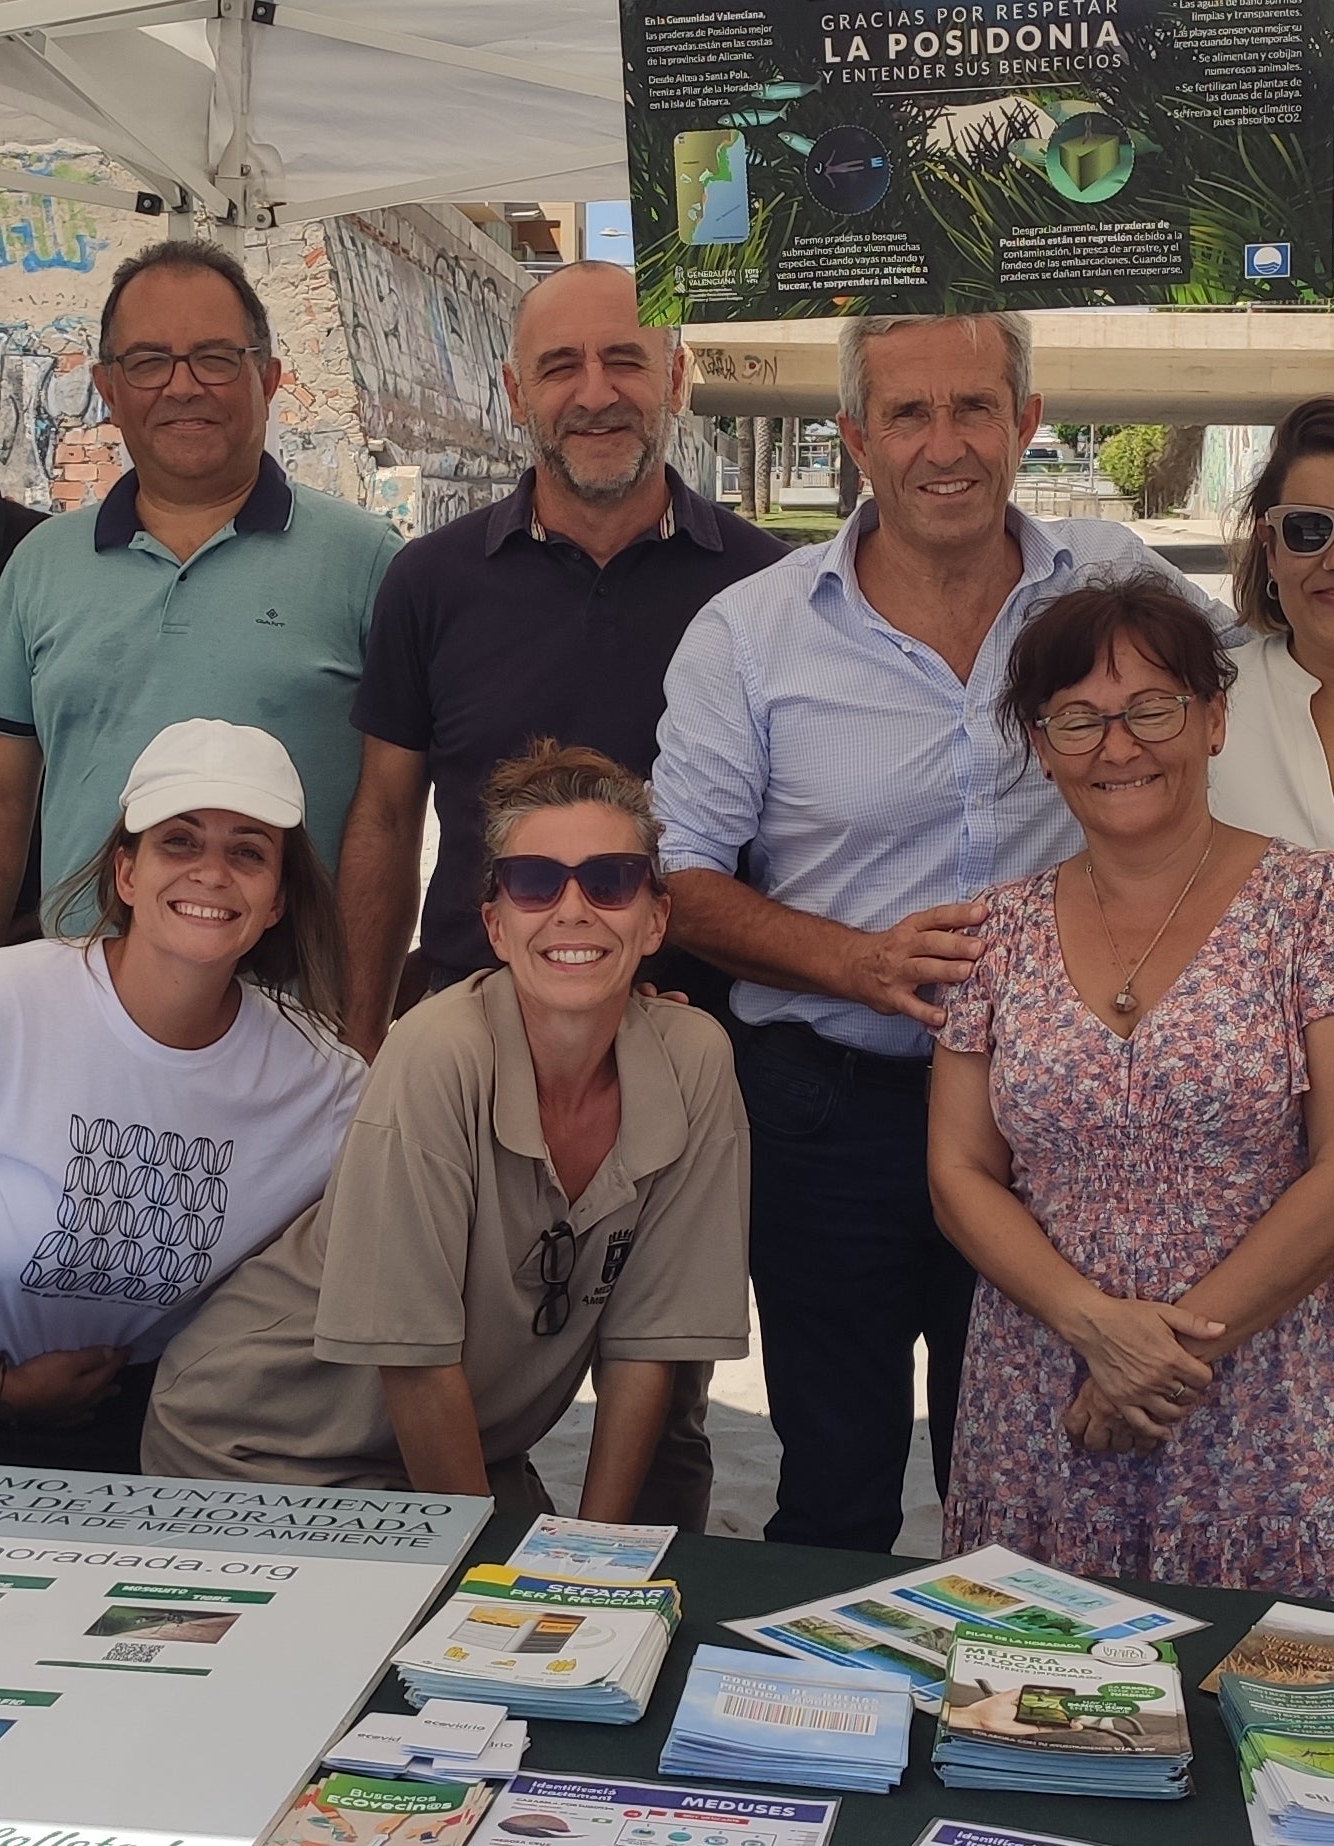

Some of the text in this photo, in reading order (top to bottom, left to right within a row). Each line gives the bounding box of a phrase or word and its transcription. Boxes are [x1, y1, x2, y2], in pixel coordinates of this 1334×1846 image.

[645, 17, 655, 26] En
[667, 13, 714, 24] Comunidad
[716, 10, 766, 21] Valenciana,
[821, 0, 1119, 31] GRACIAS POR RESPETAR
[1192, 9, 1302, 22] limpias y transparentes.
[646, 32, 657, 40] las
[659, 30, 694, 41] praderas
[708, 26, 746, 36] Posidonia
[749, 25, 773, 35] mejor
[1173, 29, 1188, 38] Las
[1190, 28, 1216, 38] playas
[1218, 25, 1263, 35] conservan
[1265, 23, 1290, 34] mejor
[823, 20, 1120, 63] LA POSIDONIA
[1199, 53, 1210, 62] Se
[1212, 52, 1258, 62] alimentan
[1268, 49, 1302, 59] cobijan
[822, 54, 1121, 85] Y ENTENDER SUS BENEFICIOS
[1205, 62, 1302, 76] numerosos animales.
[1182, 77, 1302, 92] Se fertilizan las plantas de
[1207, 89, 1302, 102] las dunas de la playa.
[1213, 118, 1235, 128] pues
[1238, 114, 1275, 124] absorbo
[86, 1483, 452, 1517] AYUNTAMIENTO
[28, 1496, 92, 1512] DE
[101, 1502, 158, 1516] LA
[168, 1503, 437, 1534] HORADADA
[81, 1517, 133, 1530] DE
[137, 1519, 251, 1537] MEDIO
[254, 1528, 434, 1548] AMBIENTE
[121, 1585, 189, 1596] MOSQUITO
[510, 1589, 660, 1605] PER A RECICLAR
[546, 1584, 666, 1598] SEPARAR
[965, 1630, 993, 1639] PILAR
[1024, 1640, 1082, 1649] HORADADA
[964, 1647, 1060, 1665] MEJORA
[963, 1654, 1094, 1675] TU LOCALIDAD
[1032, 1669, 1103, 1680] INFORMADO
[423, 1720, 486, 1732] ecovidrio
[357, 1732, 402, 1743] ecovid
[349, 1788, 437, 1802] BUSCAMOS
[533, 1781, 617, 1796] Identificació
[682, 1796, 796, 1818] MEDUSES
